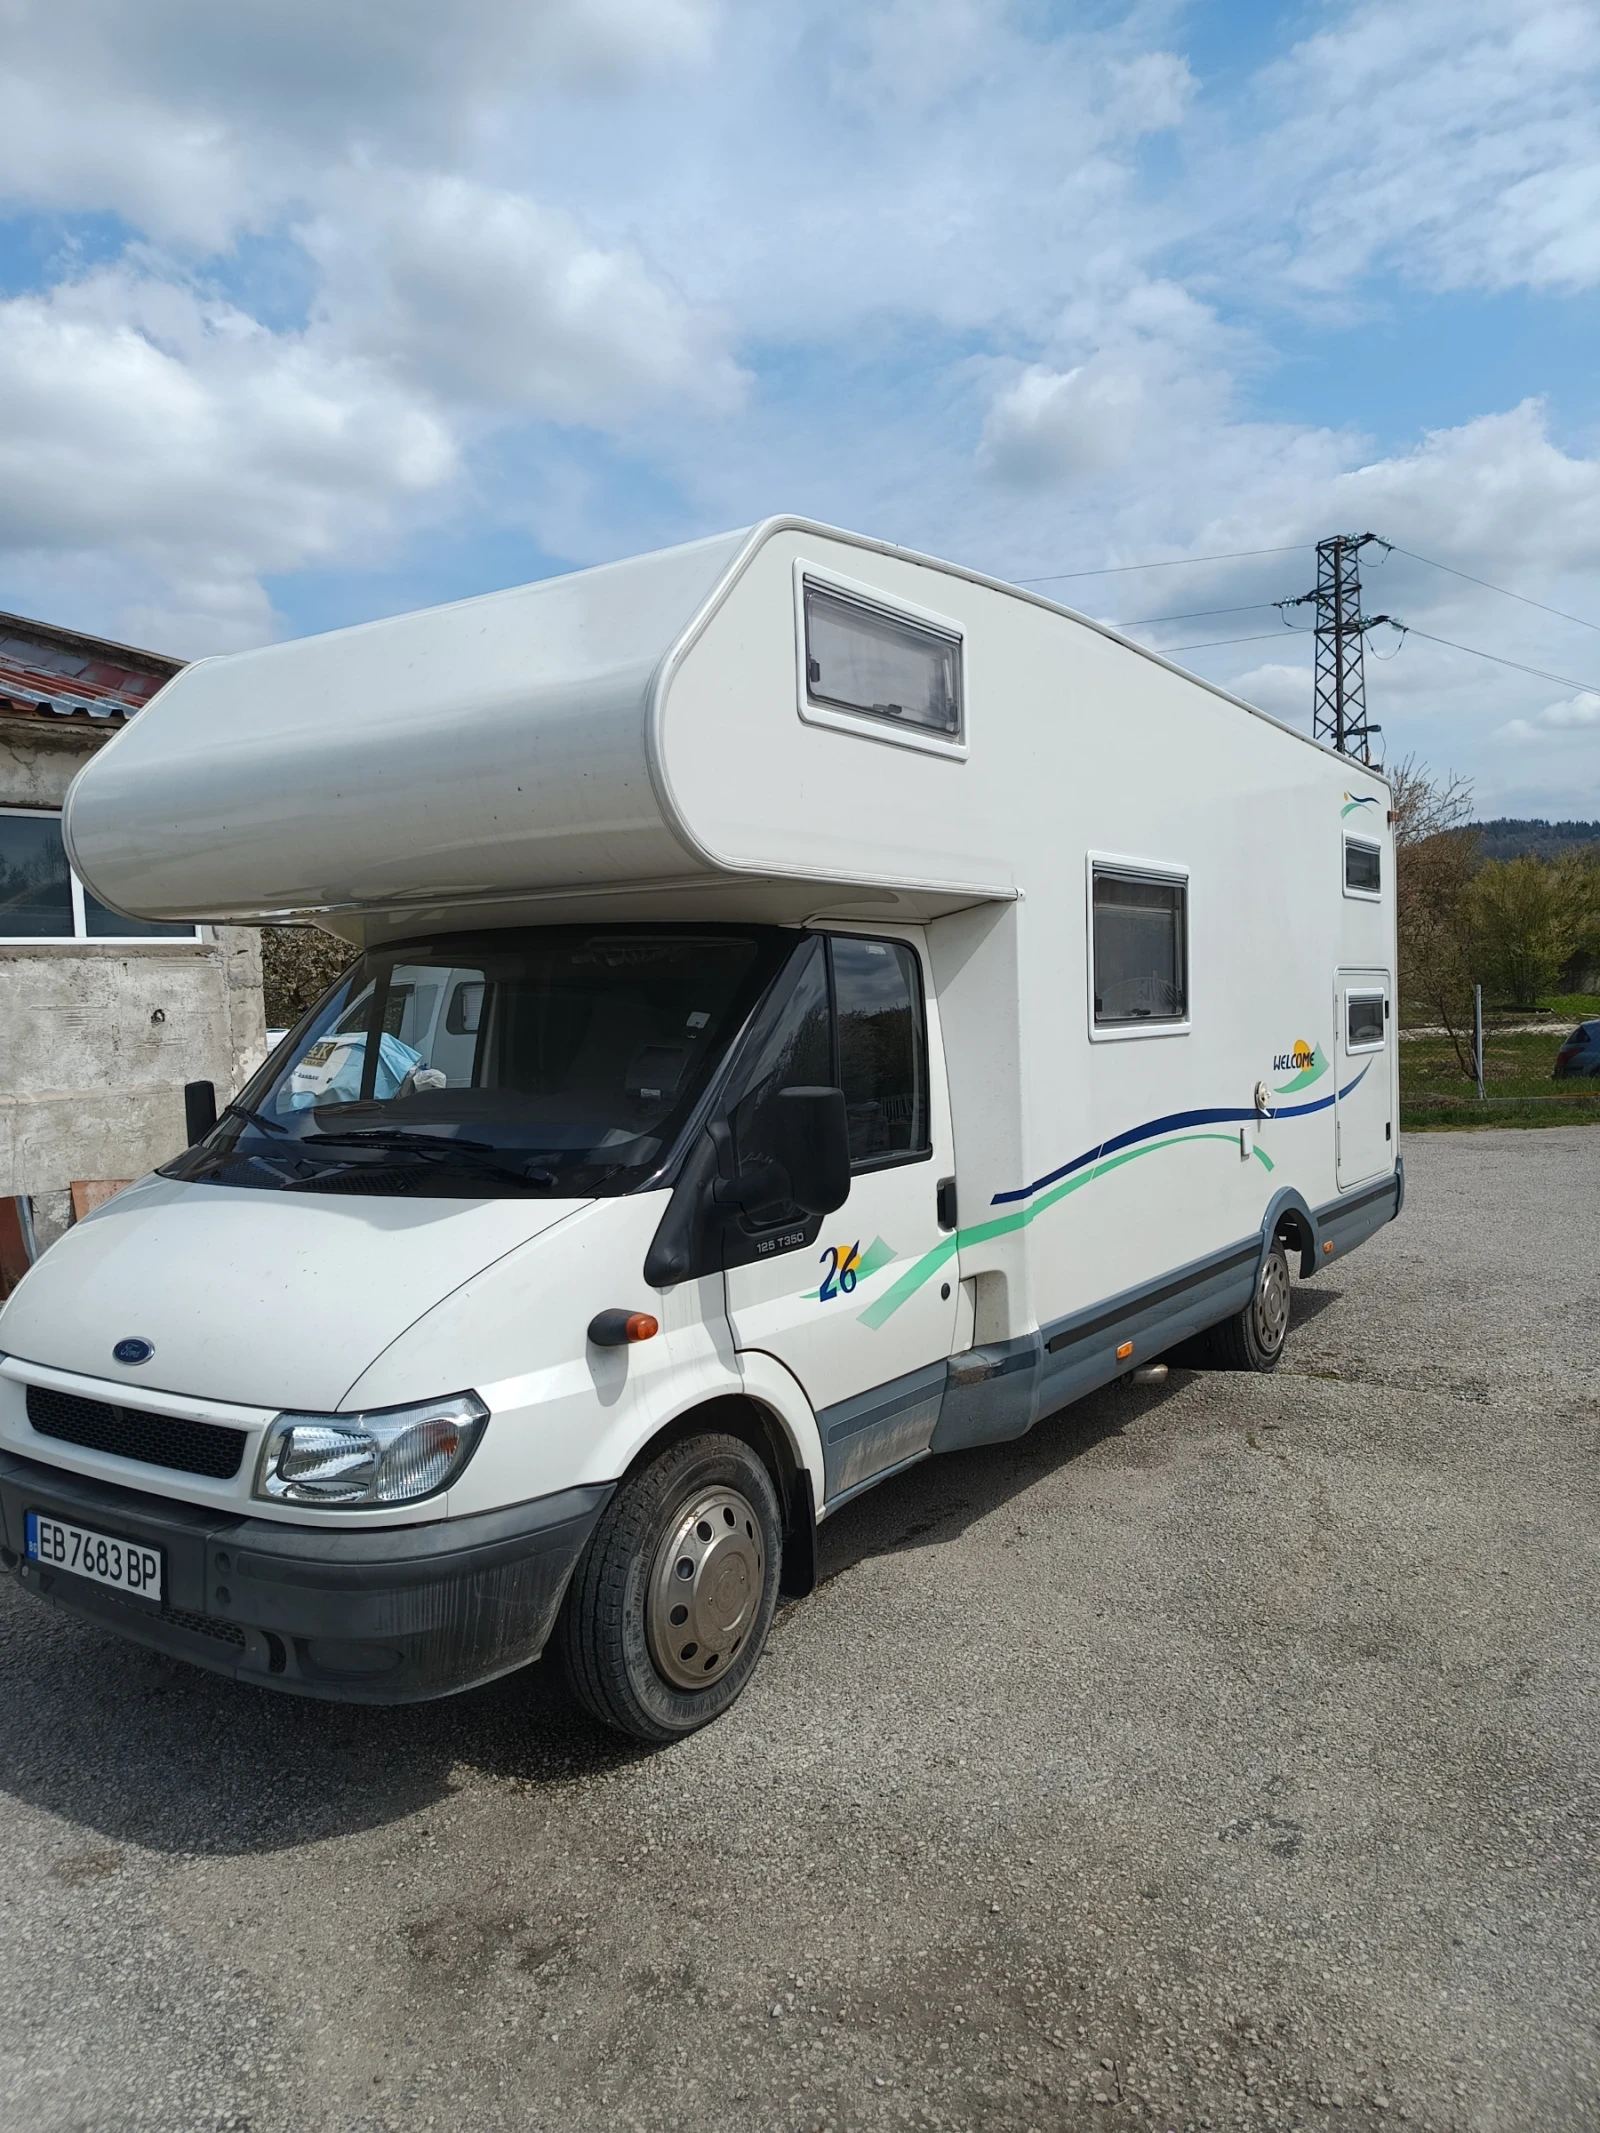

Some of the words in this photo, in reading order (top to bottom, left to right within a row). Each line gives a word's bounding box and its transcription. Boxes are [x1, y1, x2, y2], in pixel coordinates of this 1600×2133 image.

[307, 1043, 335, 1059] 4K
[1273, 1051, 1315, 1071] WELCOME
[756, 1239, 776, 1253] 125
[777, 1232, 804, 1247] T350
[819, 1239, 860, 1303] 26
[120, 1342, 143, 1358] Ford
[40, 1521, 66, 1563] EB
[69, 1531, 123, 1581] 7683
[127, 1548, 157, 1590] BP
